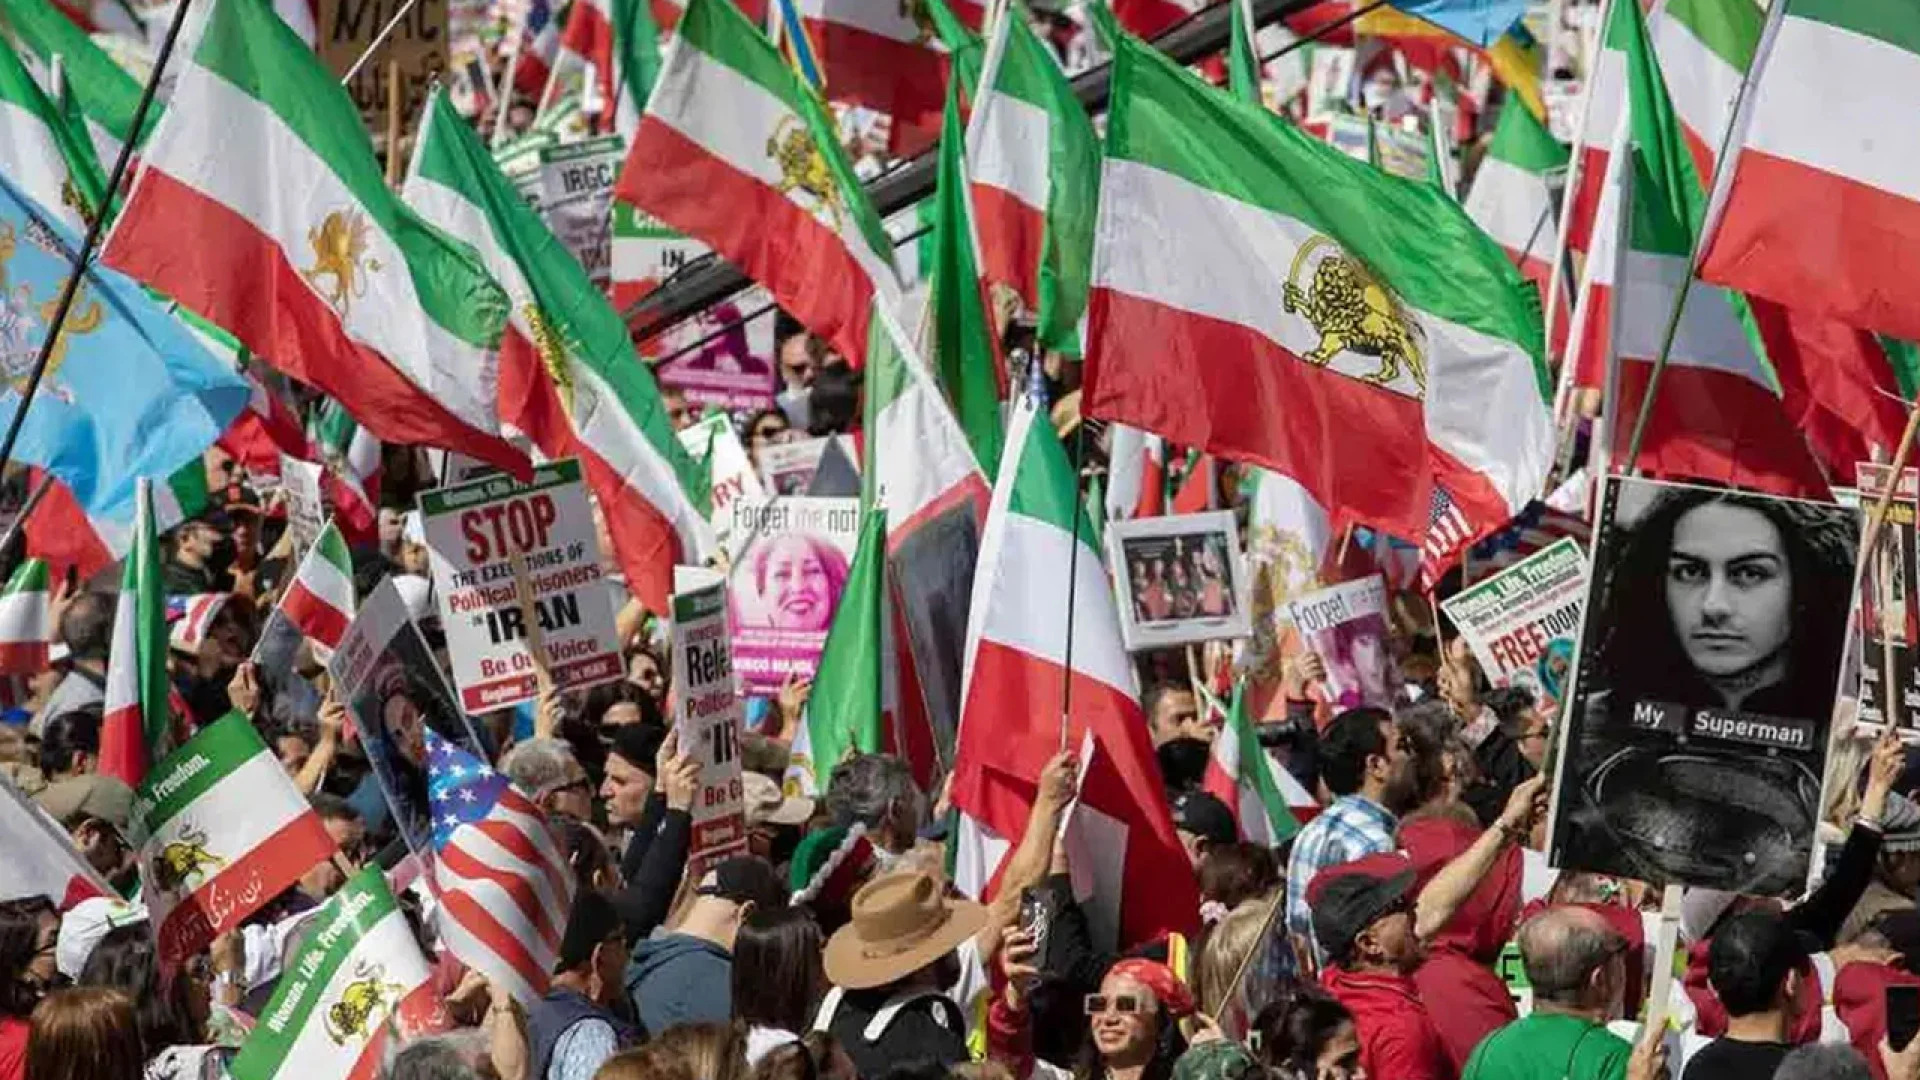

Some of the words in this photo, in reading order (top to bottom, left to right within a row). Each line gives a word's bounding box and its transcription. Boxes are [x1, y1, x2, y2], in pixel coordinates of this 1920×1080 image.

[562, 164, 613, 193] IRGC
[461, 494, 556, 564] STOP
[733, 500, 790, 537] Forget
[827, 507, 857, 532] not
[448, 581, 517, 613] Political
[530, 562, 600, 594] risoners
[453, 568, 479, 589] THE
[482, 547, 564, 579] EXECTIONS
[486, 593, 580, 644] IRAN
[1288, 592, 1350, 632] Forget
[1538, 598, 1584, 639] TOOM
[480, 657, 507, 678] Be
[547, 638, 598, 661] Voice
[1633, 702, 1665, 729] My
[1694, 710, 1804, 744] Superman
[152, 753, 211, 802] Freedom.
